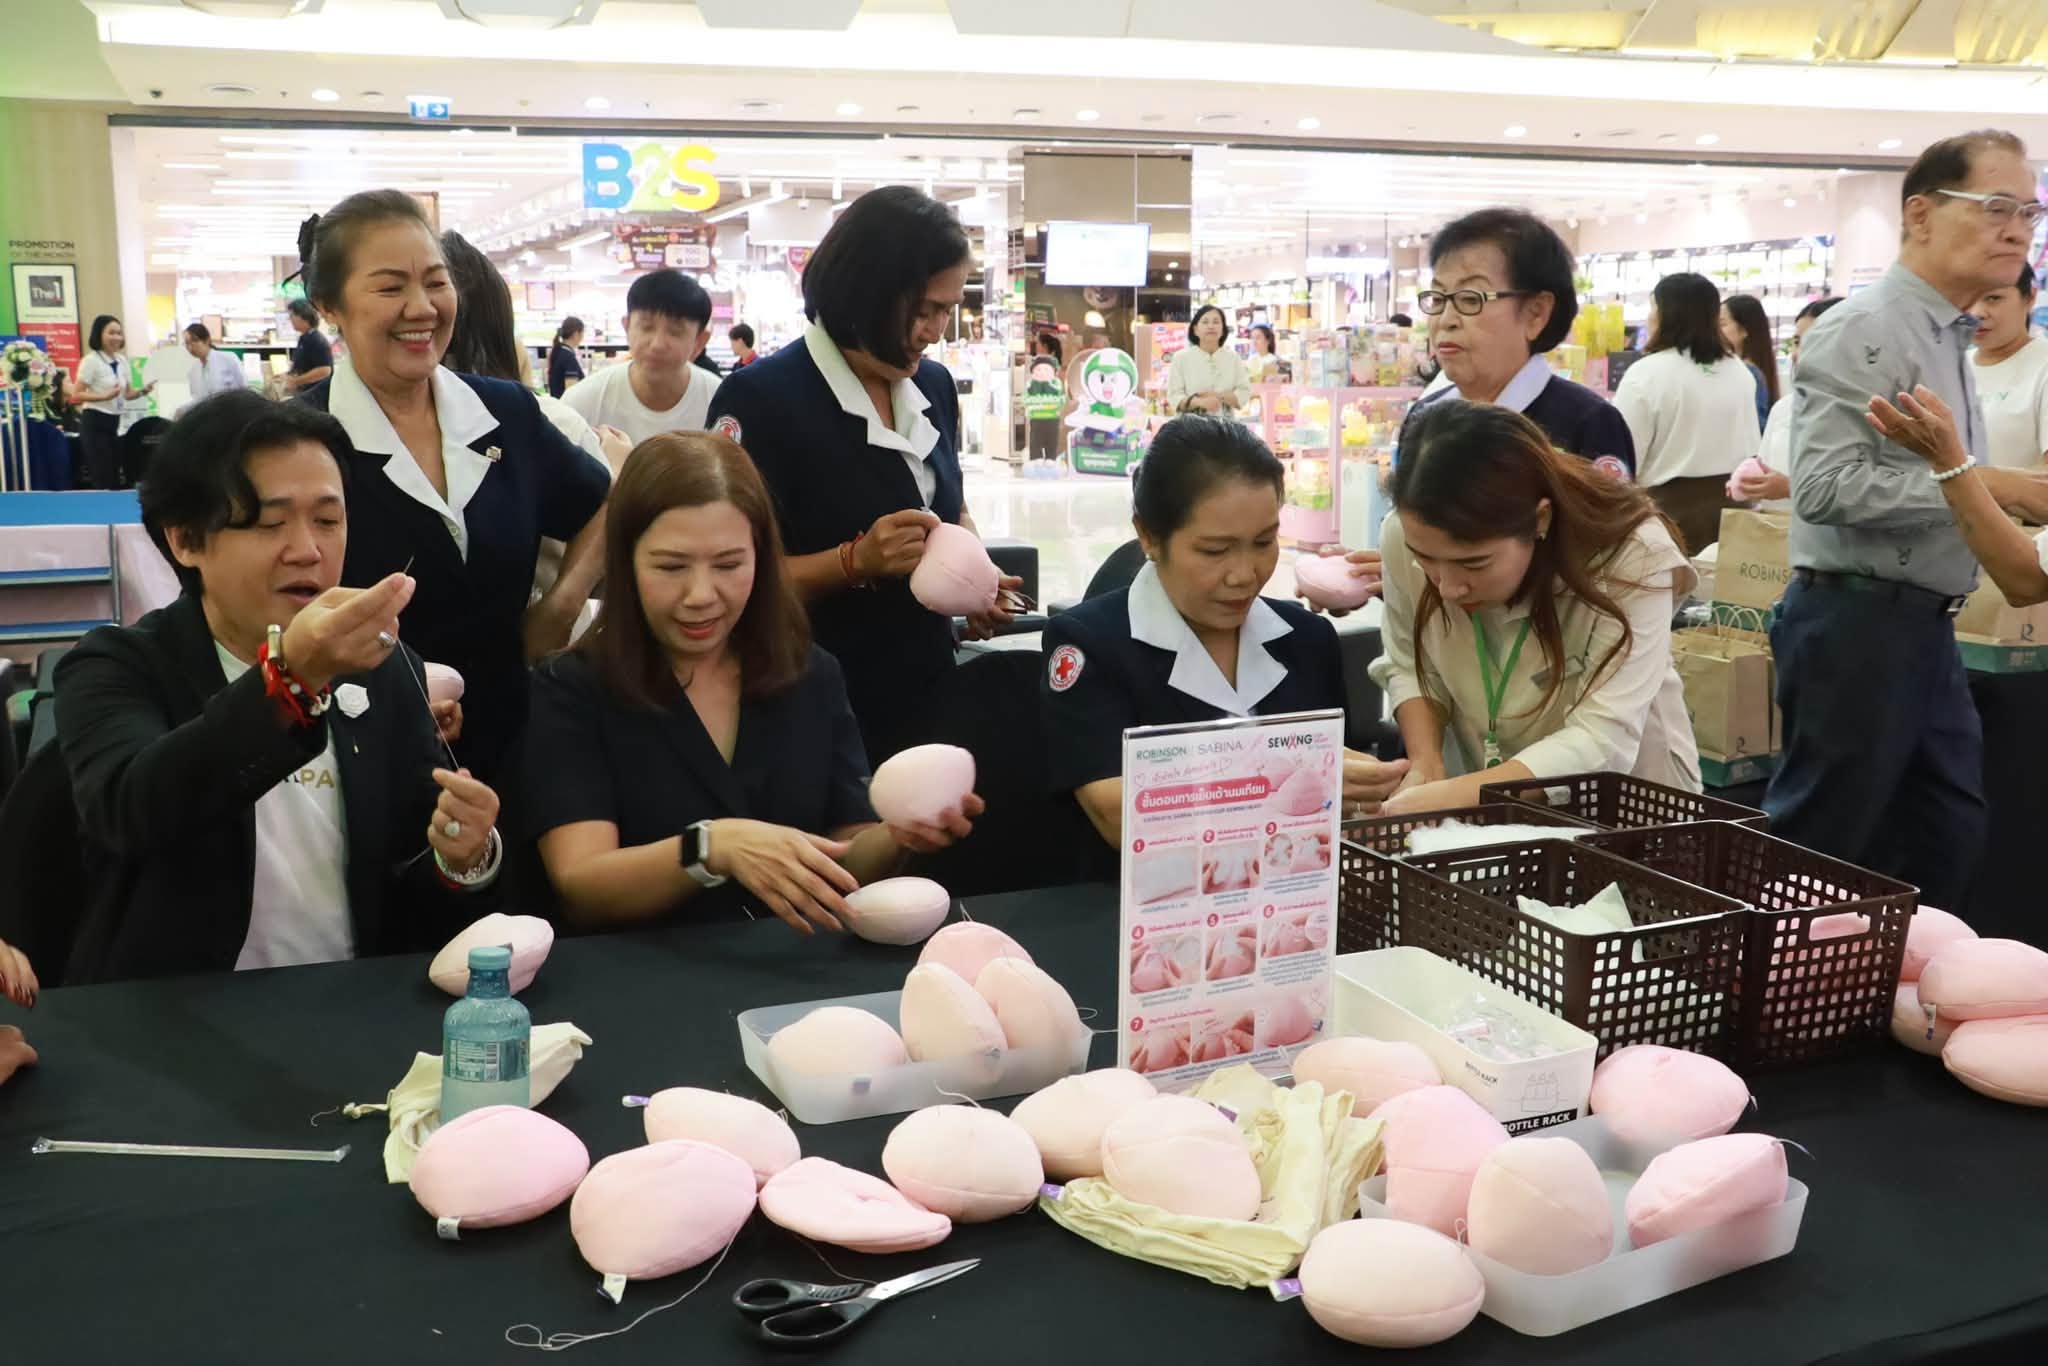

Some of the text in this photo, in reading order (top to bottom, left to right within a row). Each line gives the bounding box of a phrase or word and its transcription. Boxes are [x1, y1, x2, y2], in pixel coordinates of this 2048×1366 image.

[582, 142, 720, 211] B2S
[8, 240, 75, 249] PROMOTION
[1136, 745, 1187, 760] ROBINSON
[1198, 740, 1244, 756] SABINA
[1542, 1111, 1570, 1126] RACK
